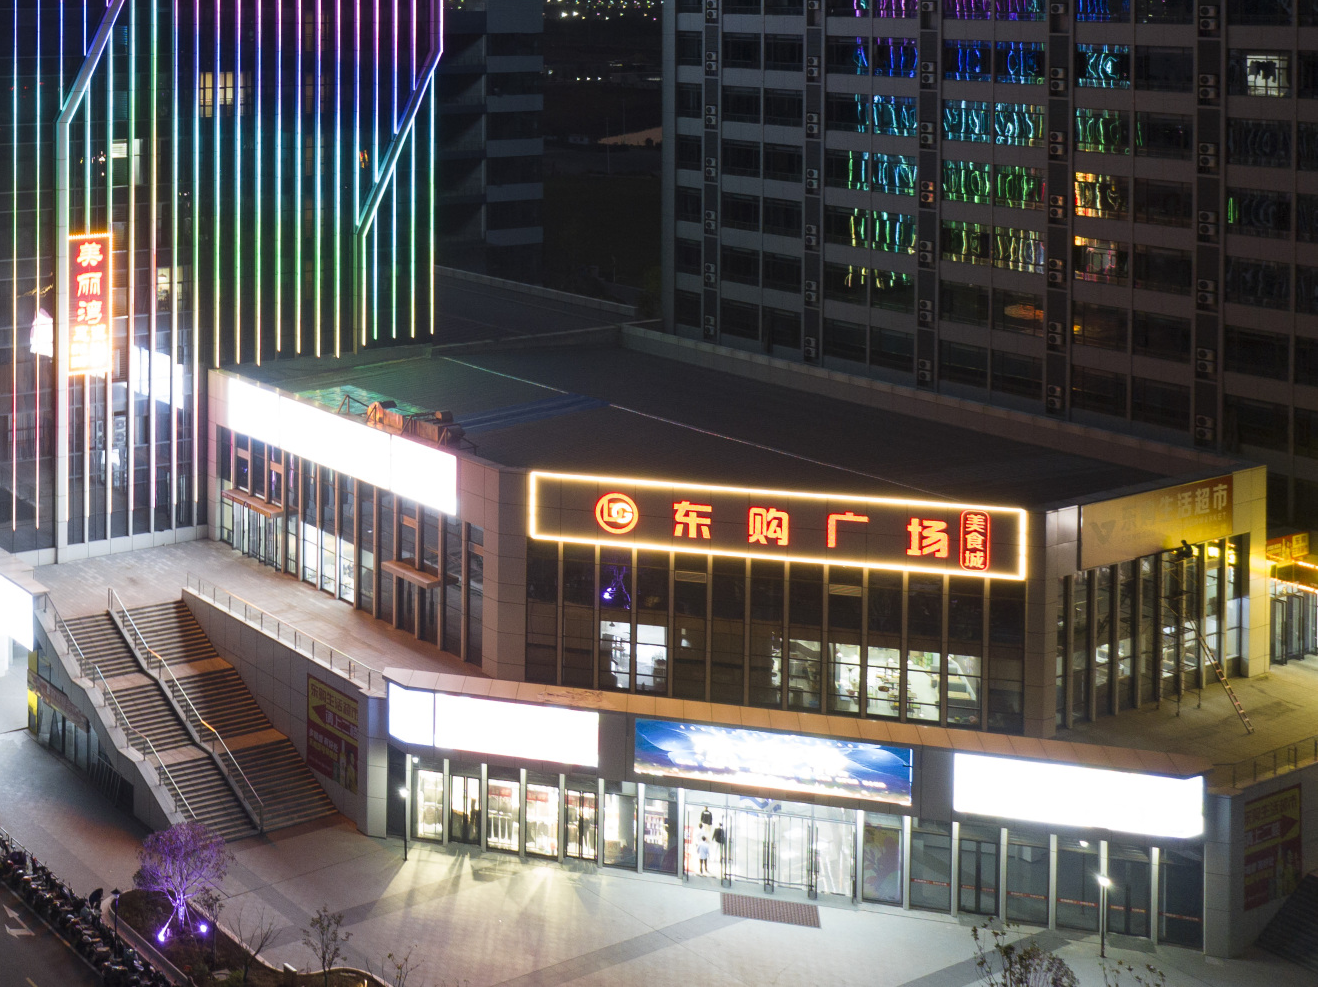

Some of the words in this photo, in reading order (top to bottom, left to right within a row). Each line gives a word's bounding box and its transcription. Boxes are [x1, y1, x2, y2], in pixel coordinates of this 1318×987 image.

[76, 241, 104, 325] 美丽湾
[672, 500, 949, 559] 东购广场
[964, 513, 987, 570] 美食城
